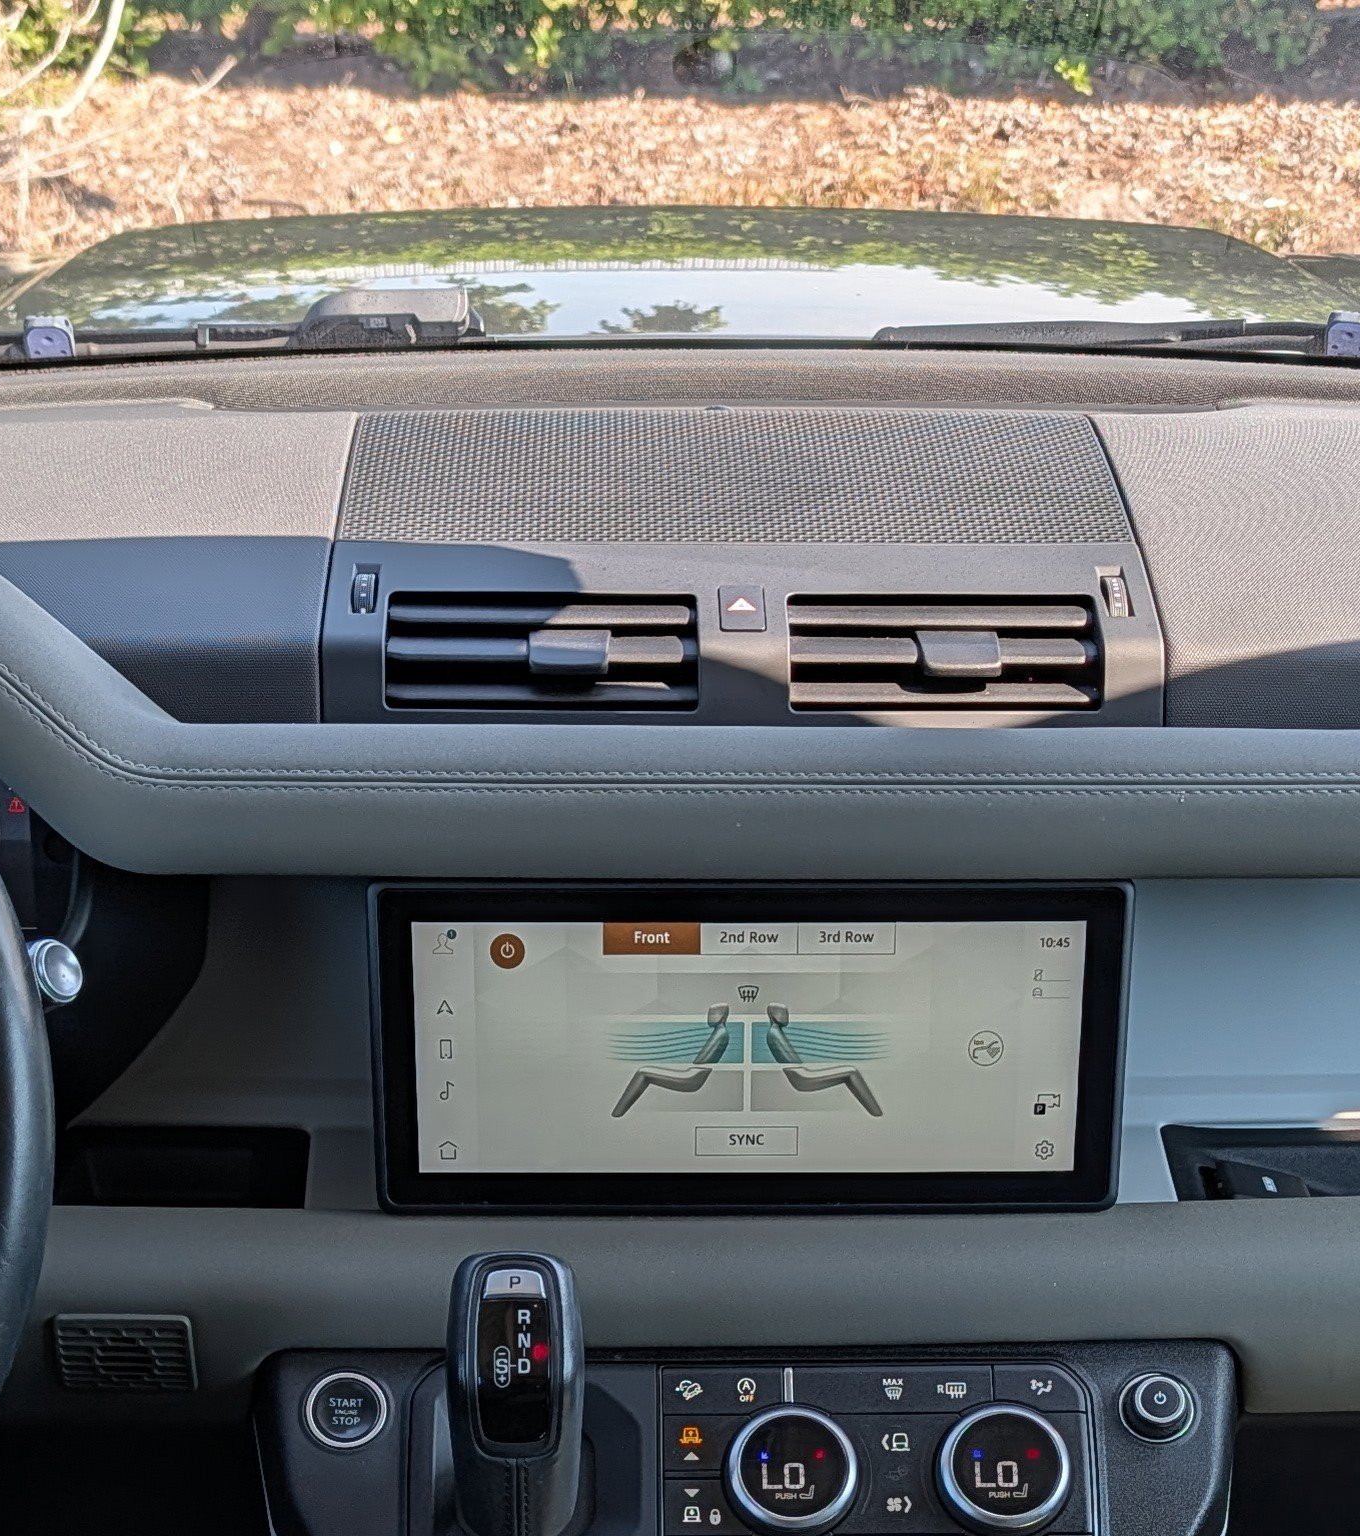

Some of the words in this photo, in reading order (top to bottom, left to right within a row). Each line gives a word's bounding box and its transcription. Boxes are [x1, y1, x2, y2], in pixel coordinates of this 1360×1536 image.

[634, 930, 670, 943] Front
[719, 930, 745, 943] 2nd
[749, 931, 779, 943] Row
[819, 930, 841, 943] 3rd
[845, 931, 875, 943] Row
[1040, 937, 1070, 948] 10:45
[728, 1134, 765, 1145] SYNC
[509, 1276, 521, 1289] P
[517, 1309, 531, 1325] R
[517, 1332, 531, 1348] N
[495, 1358, 508, 1374] S
[517, 1358, 531, 1374] D
[882, 1378, 903, 1386] MAX
[937, 1384, 944, 1394] R
[329, 1398, 363, 1407] START
[332, 1416, 360, 1425] STOP
[761, 1462, 806, 1490] LO
[974, 1460, 1019, 1488] LO
[775, 1492, 797, 1500] PUSH
